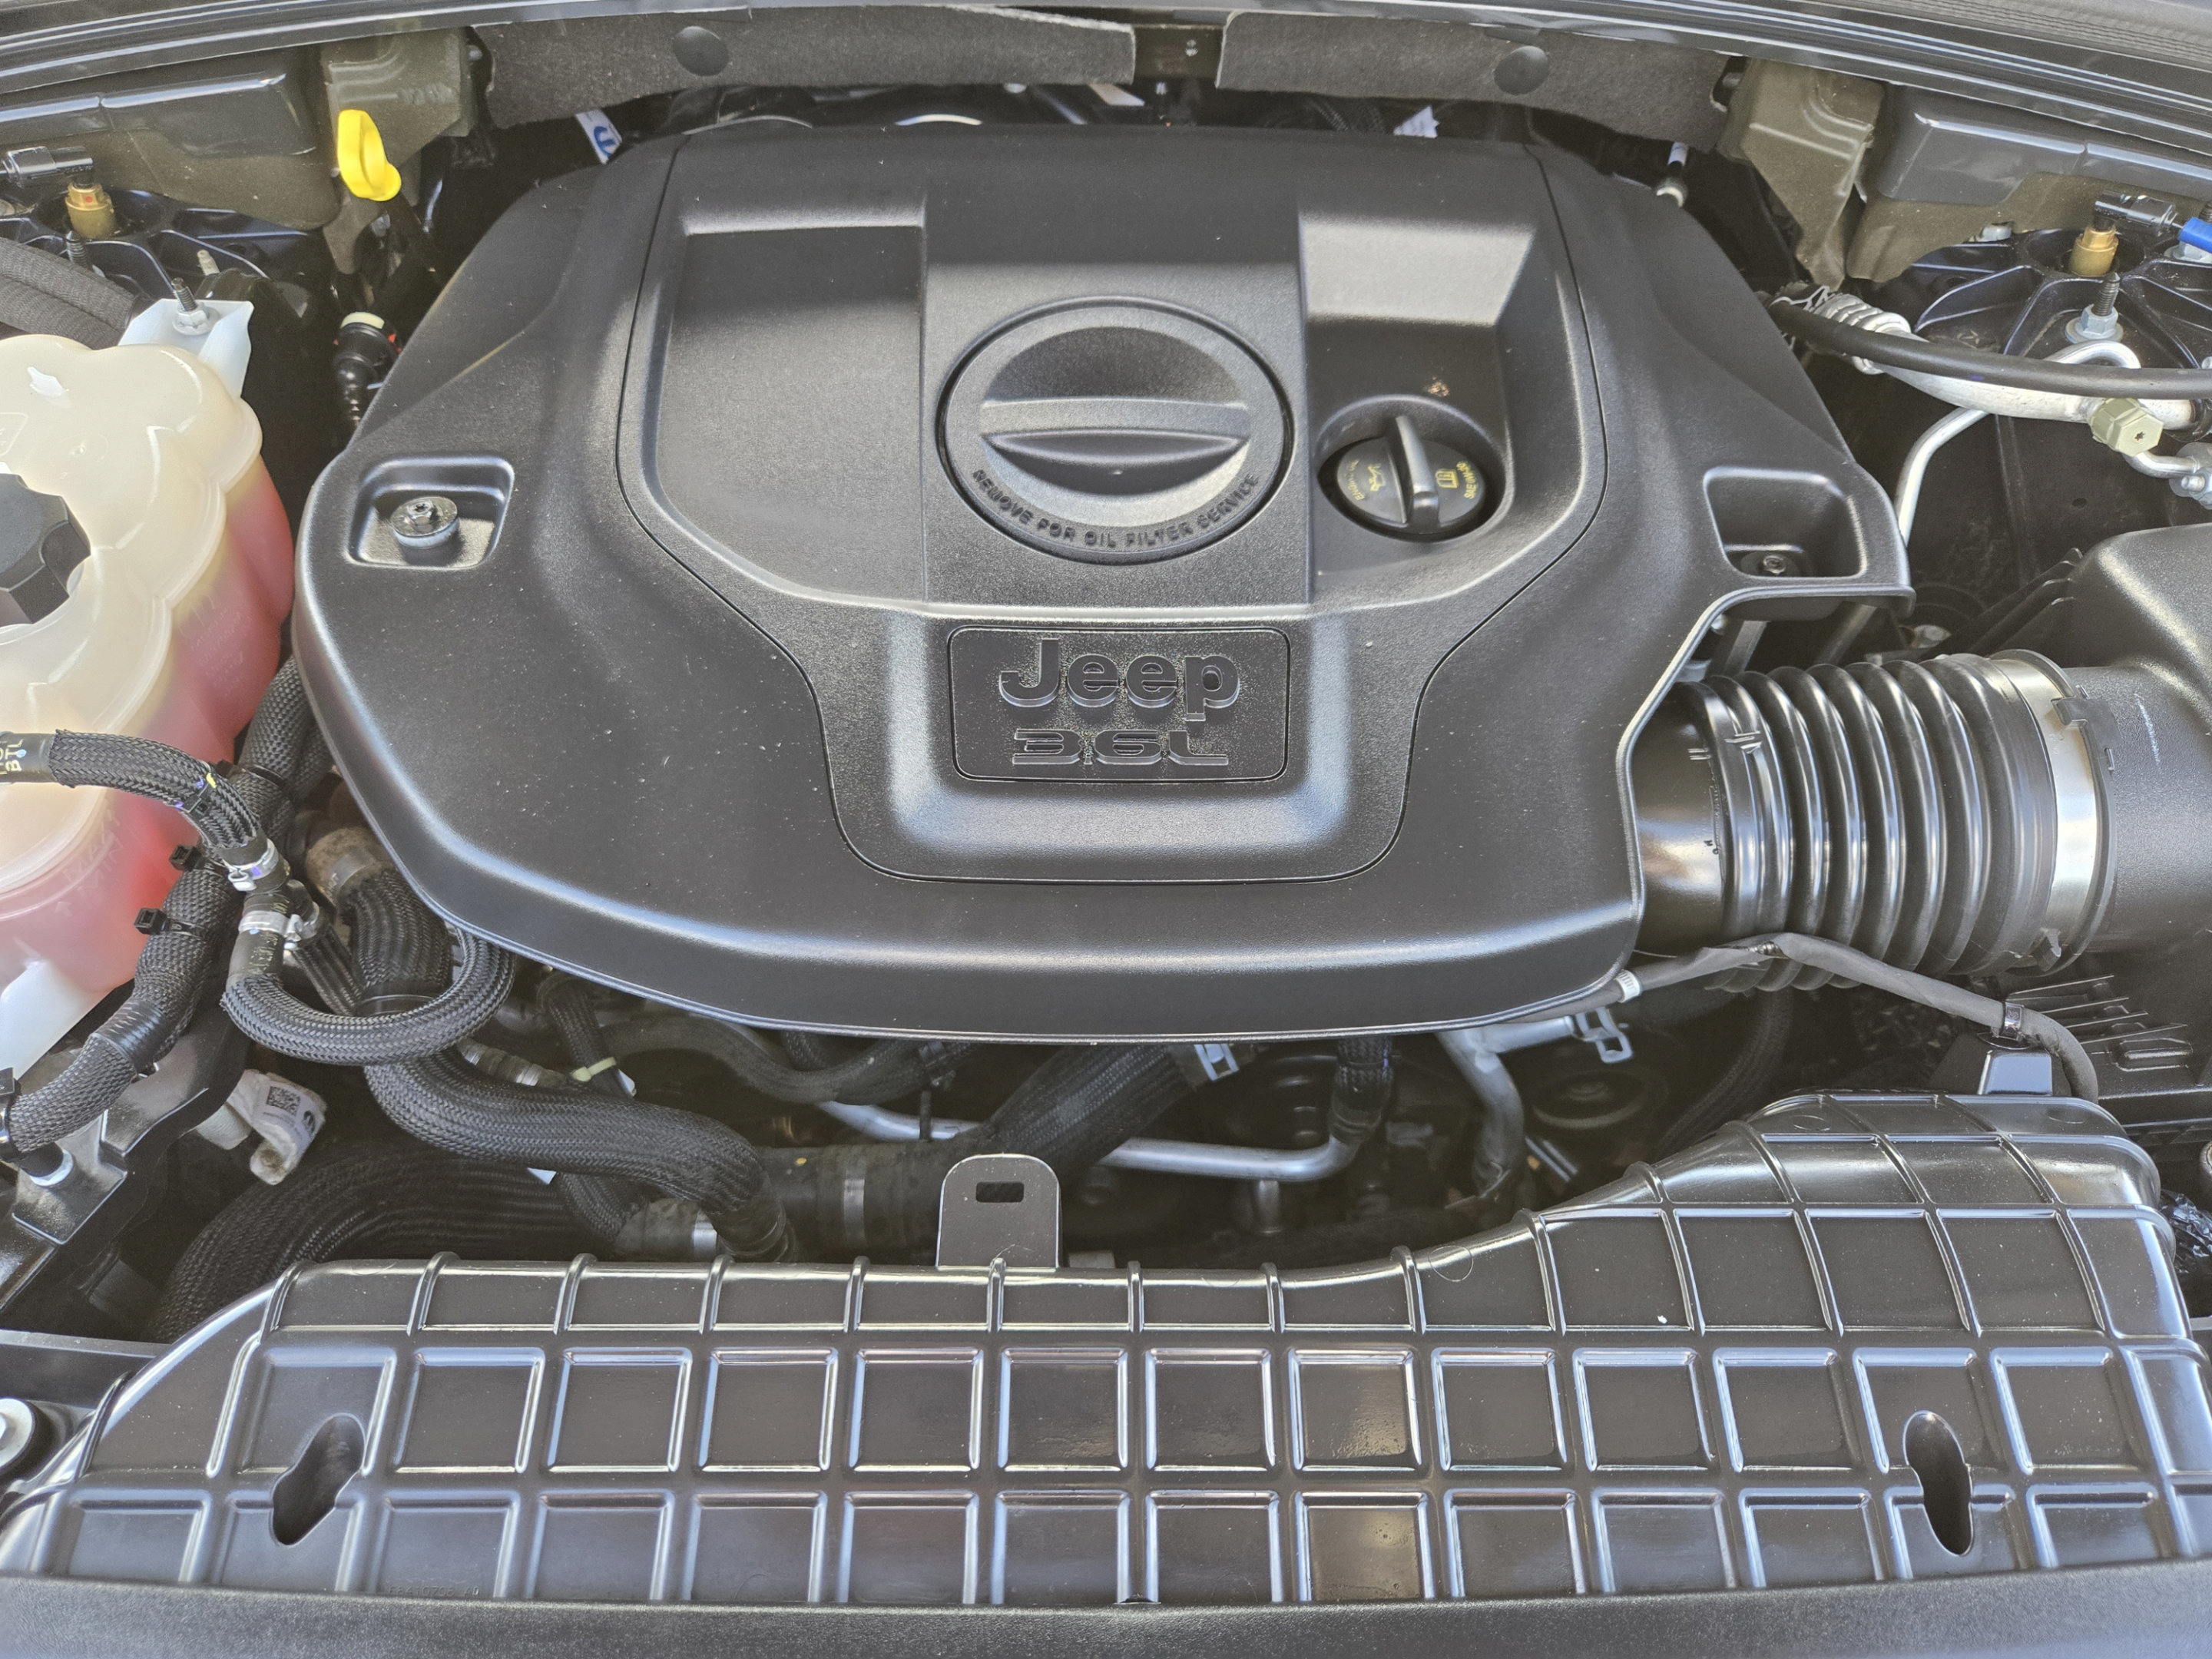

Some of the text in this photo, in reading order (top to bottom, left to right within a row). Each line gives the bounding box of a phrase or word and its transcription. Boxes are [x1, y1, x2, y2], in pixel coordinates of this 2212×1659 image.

[972, 469, 1260, 548] REMOVE FOR OIL FILTER SERVICE
[1000, 638, 1240, 721] Jeep
